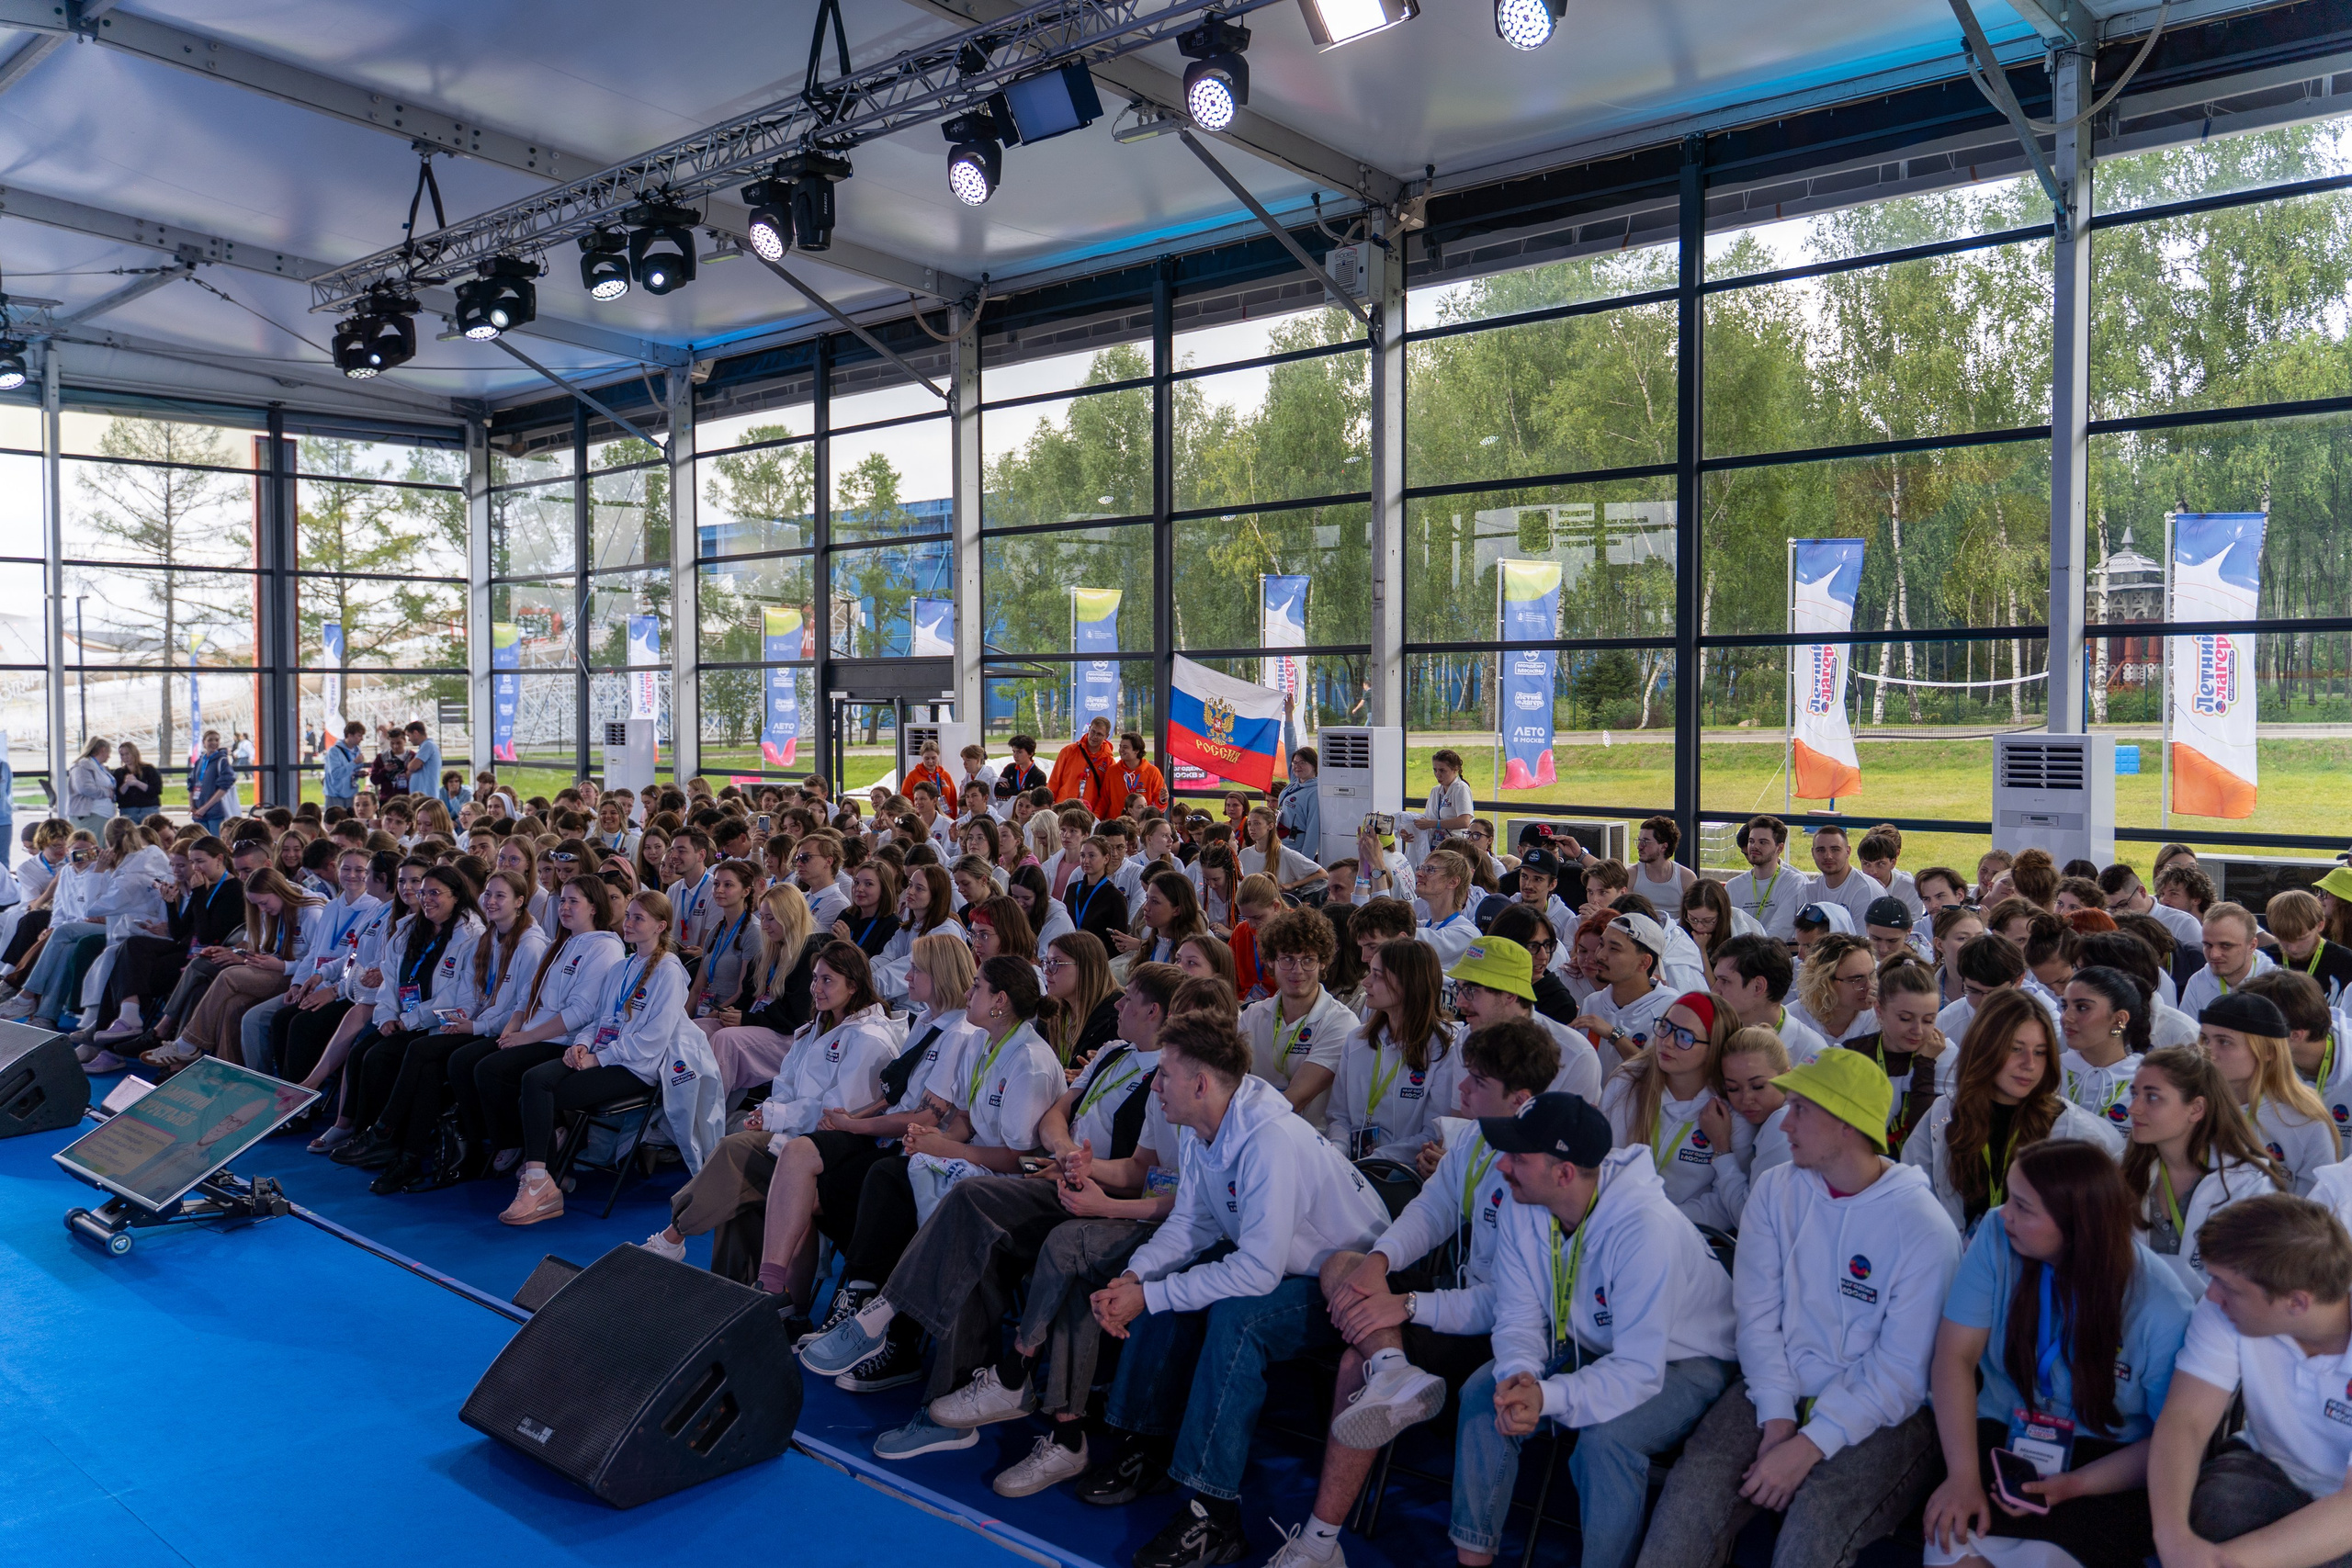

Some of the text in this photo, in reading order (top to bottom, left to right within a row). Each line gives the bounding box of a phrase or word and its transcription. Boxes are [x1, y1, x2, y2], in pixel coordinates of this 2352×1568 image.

[2215, 634, 2231, 700] лагер
[1514, 727, 1544, 737] ЛЕТО
[1195, 739, 1240, 764] РОССИЯ
